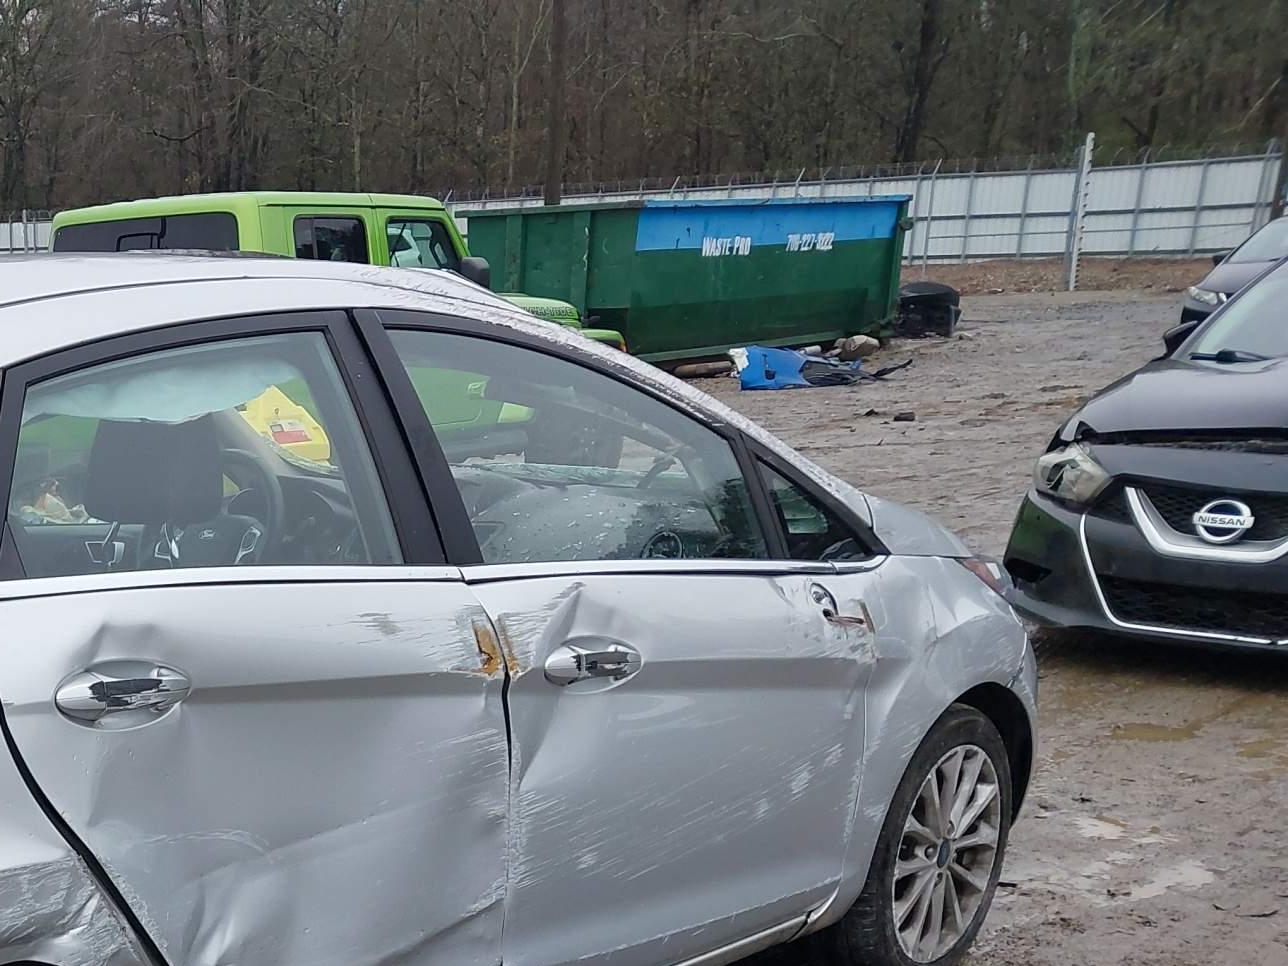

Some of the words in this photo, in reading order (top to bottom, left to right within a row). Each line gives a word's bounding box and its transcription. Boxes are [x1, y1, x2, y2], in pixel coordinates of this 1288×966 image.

[702, 236, 732, 257] WASTE
[732, 235, 752, 257] PRO
[1198, 515, 1246, 526] NISSAN
